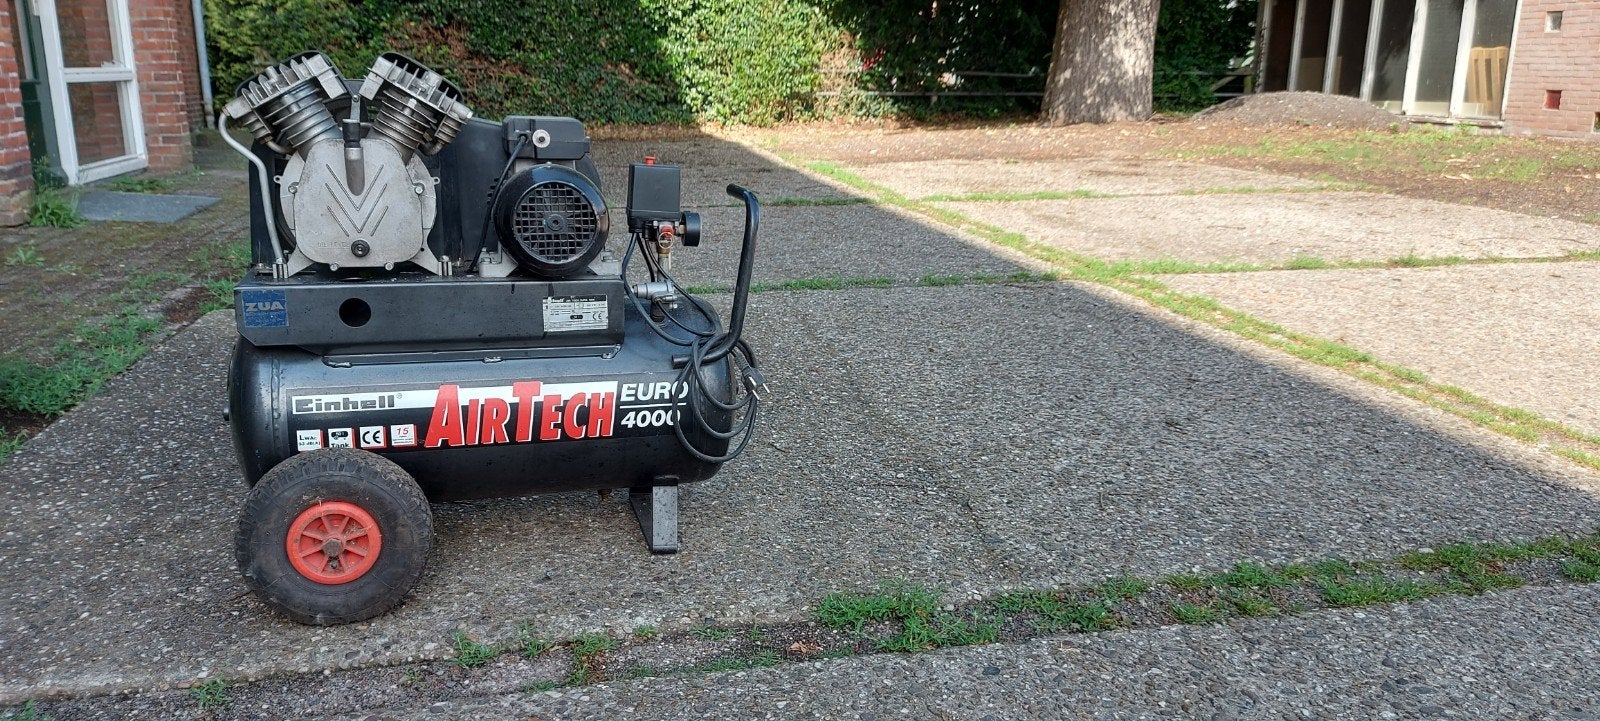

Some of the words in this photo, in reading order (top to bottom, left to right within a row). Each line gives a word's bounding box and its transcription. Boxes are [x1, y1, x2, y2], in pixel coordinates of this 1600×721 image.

[245, 301, 284, 312] ZUA
[620, 381, 689, 401] EURO
[620, 410, 681, 429] 4000
[362, 430, 381, 445] CE
[397, 427, 409, 435] 15
